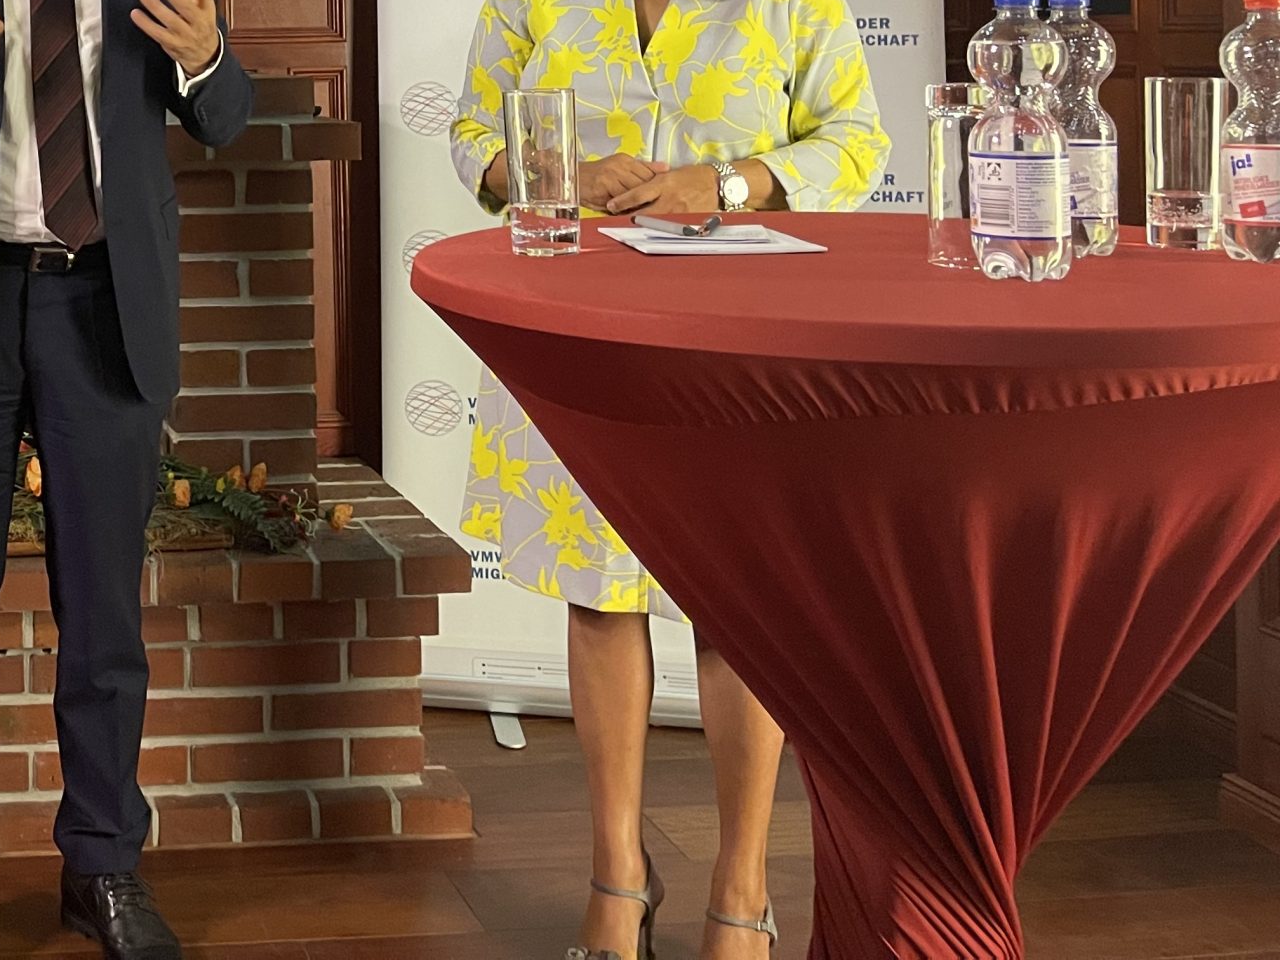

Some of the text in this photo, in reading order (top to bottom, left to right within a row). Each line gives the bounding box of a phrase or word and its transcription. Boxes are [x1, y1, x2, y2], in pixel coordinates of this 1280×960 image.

[856, 17, 890, 29] DER
[1230, 153, 1253, 176] ja!
[471, 567, 506, 580] MIG
